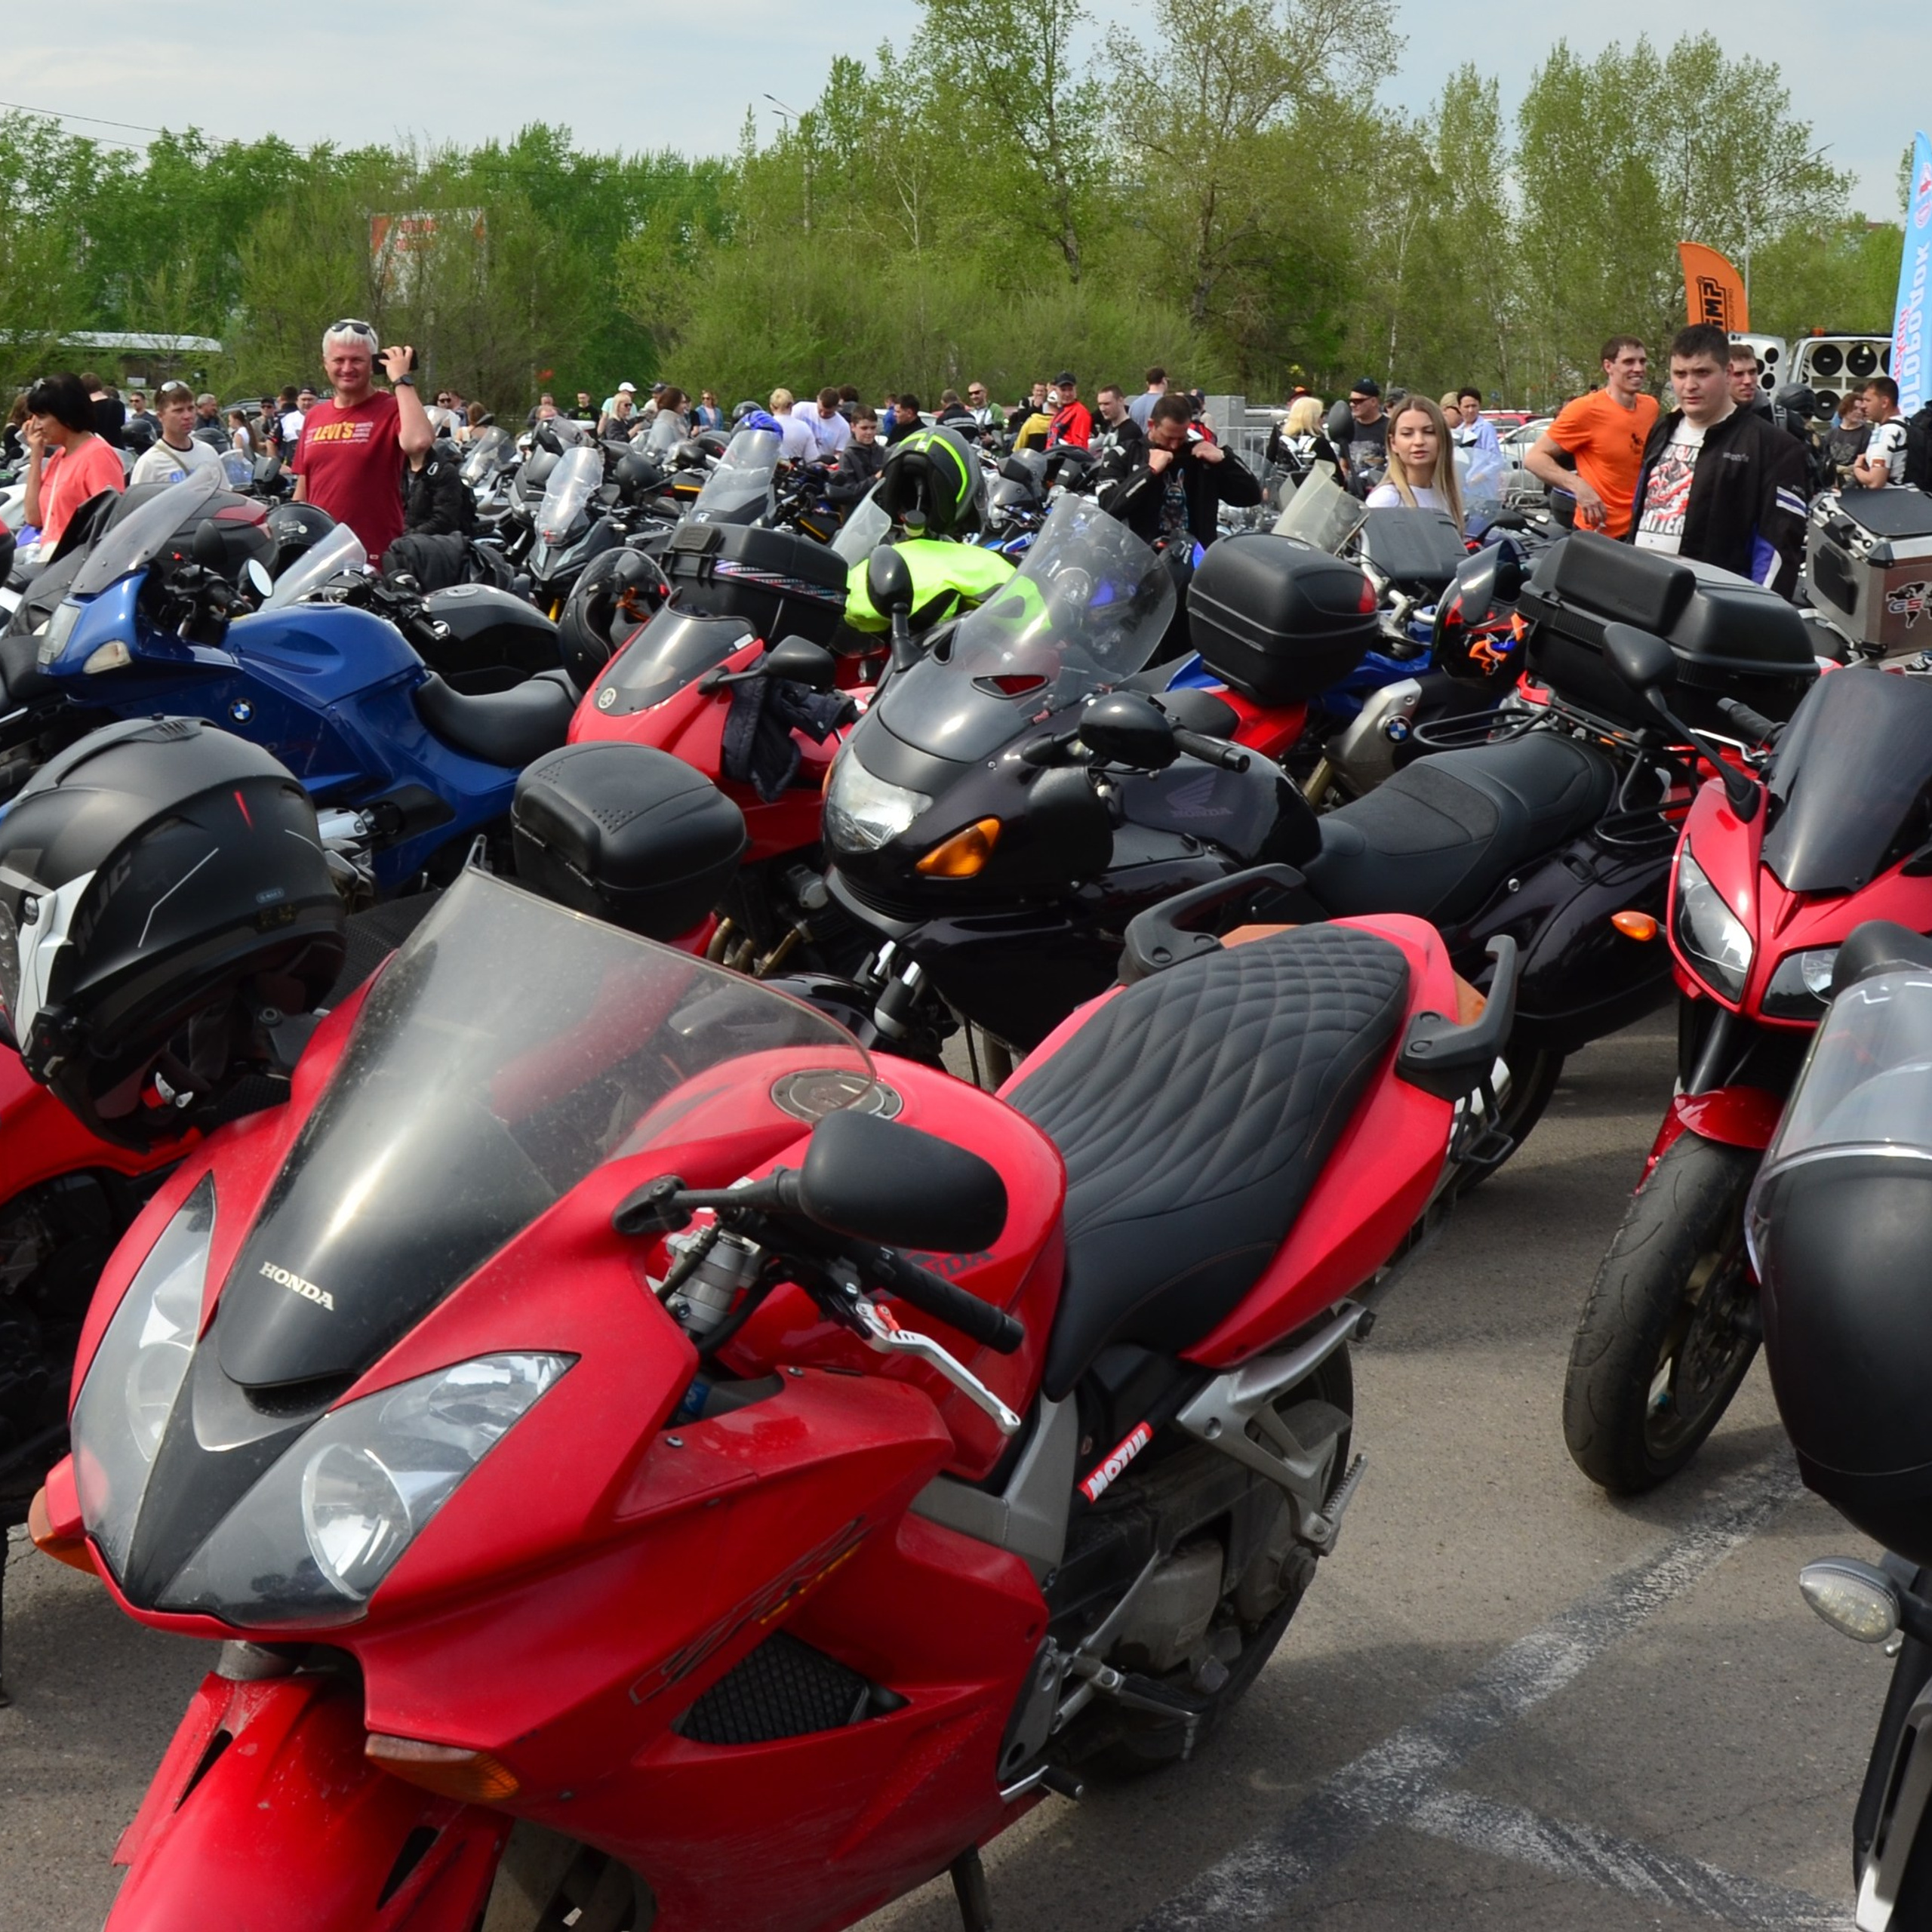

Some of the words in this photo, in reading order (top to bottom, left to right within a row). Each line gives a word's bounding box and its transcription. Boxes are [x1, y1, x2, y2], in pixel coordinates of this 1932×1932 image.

[313, 421, 356, 441] LEVI'S
[1889, 598, 1923, 612] GS
[1171, 808, 1233, 818] HONDA
[76, 851, 131, 957] HJC
[259, 1261, 334, 1311] HONDA
[1088, 1429, 1149, 1501] MOTUL
